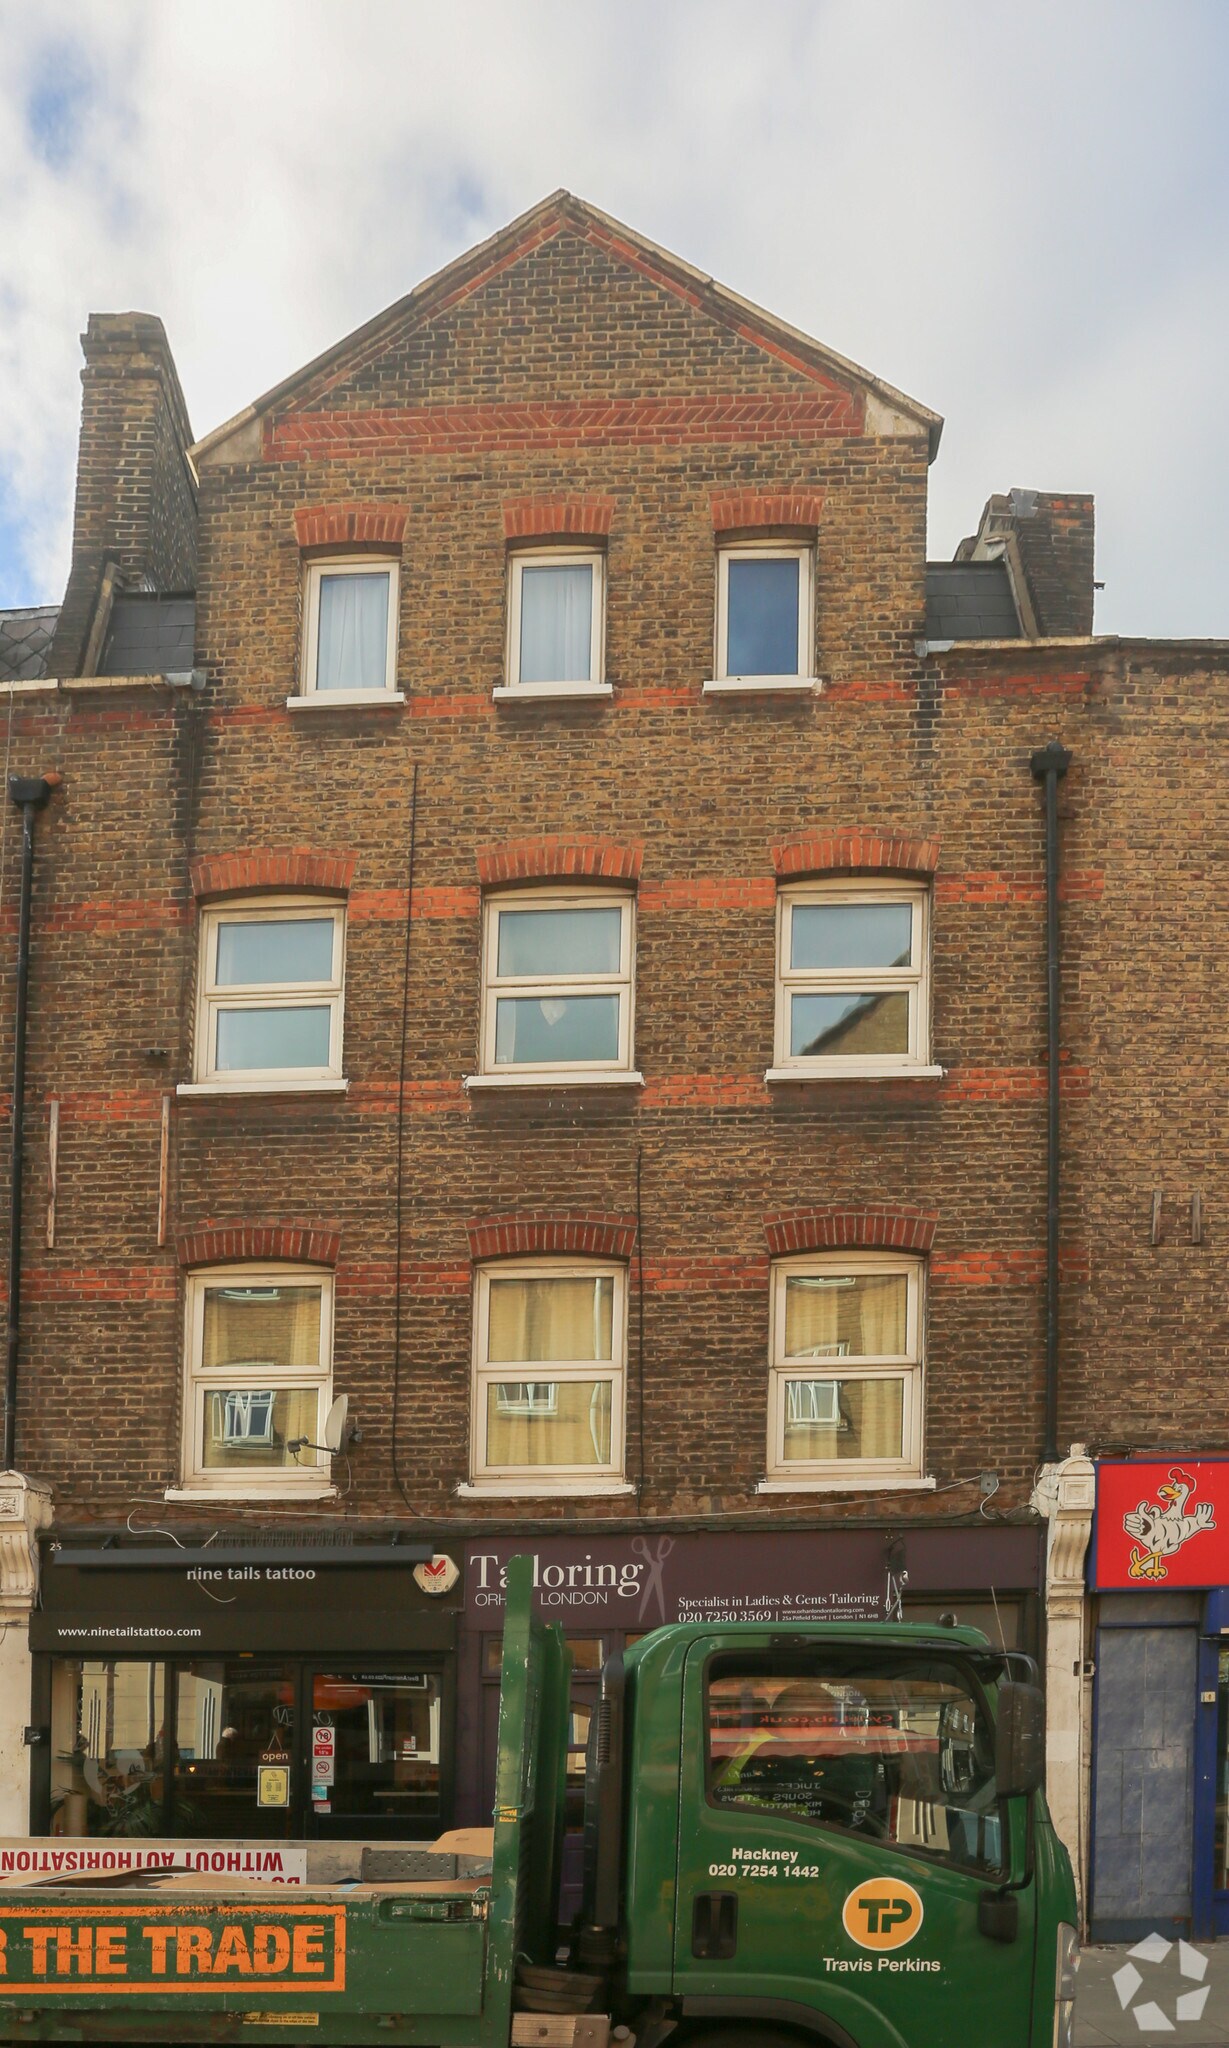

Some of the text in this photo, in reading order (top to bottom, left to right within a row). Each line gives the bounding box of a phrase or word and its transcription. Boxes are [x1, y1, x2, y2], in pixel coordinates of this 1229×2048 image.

[50, 1543, 62, 1551] 25
[187, 1567, 316, 1580] nine tails tattoo
[469, 1554, 644, 1597] Tloring
[475, 1592, 608, 1606] ORH LONDON
[678, 1593, 880, 1610] Specialist in Ladies & Gents Tailoring
[678, 1610, 772, 1623] 020 7250 3569
[57, 1627, 202, 1637] www.ninetailstattoo.com
[262, 1752, 289, 1762] open
[1, 1851, 284, 1872] WITHOUT AUTHORISATION
[731, 1848, 799, 1864] Hackney
[709, 1864, 819, 1878] 020 7254 1442
[858, 1898, 913, 1933] TP
[23, 1926, 128, 1975] THE
[142, 1925, 325, 1974] TRADE
[823, 1958, 941, 1972] Travis Perkins
